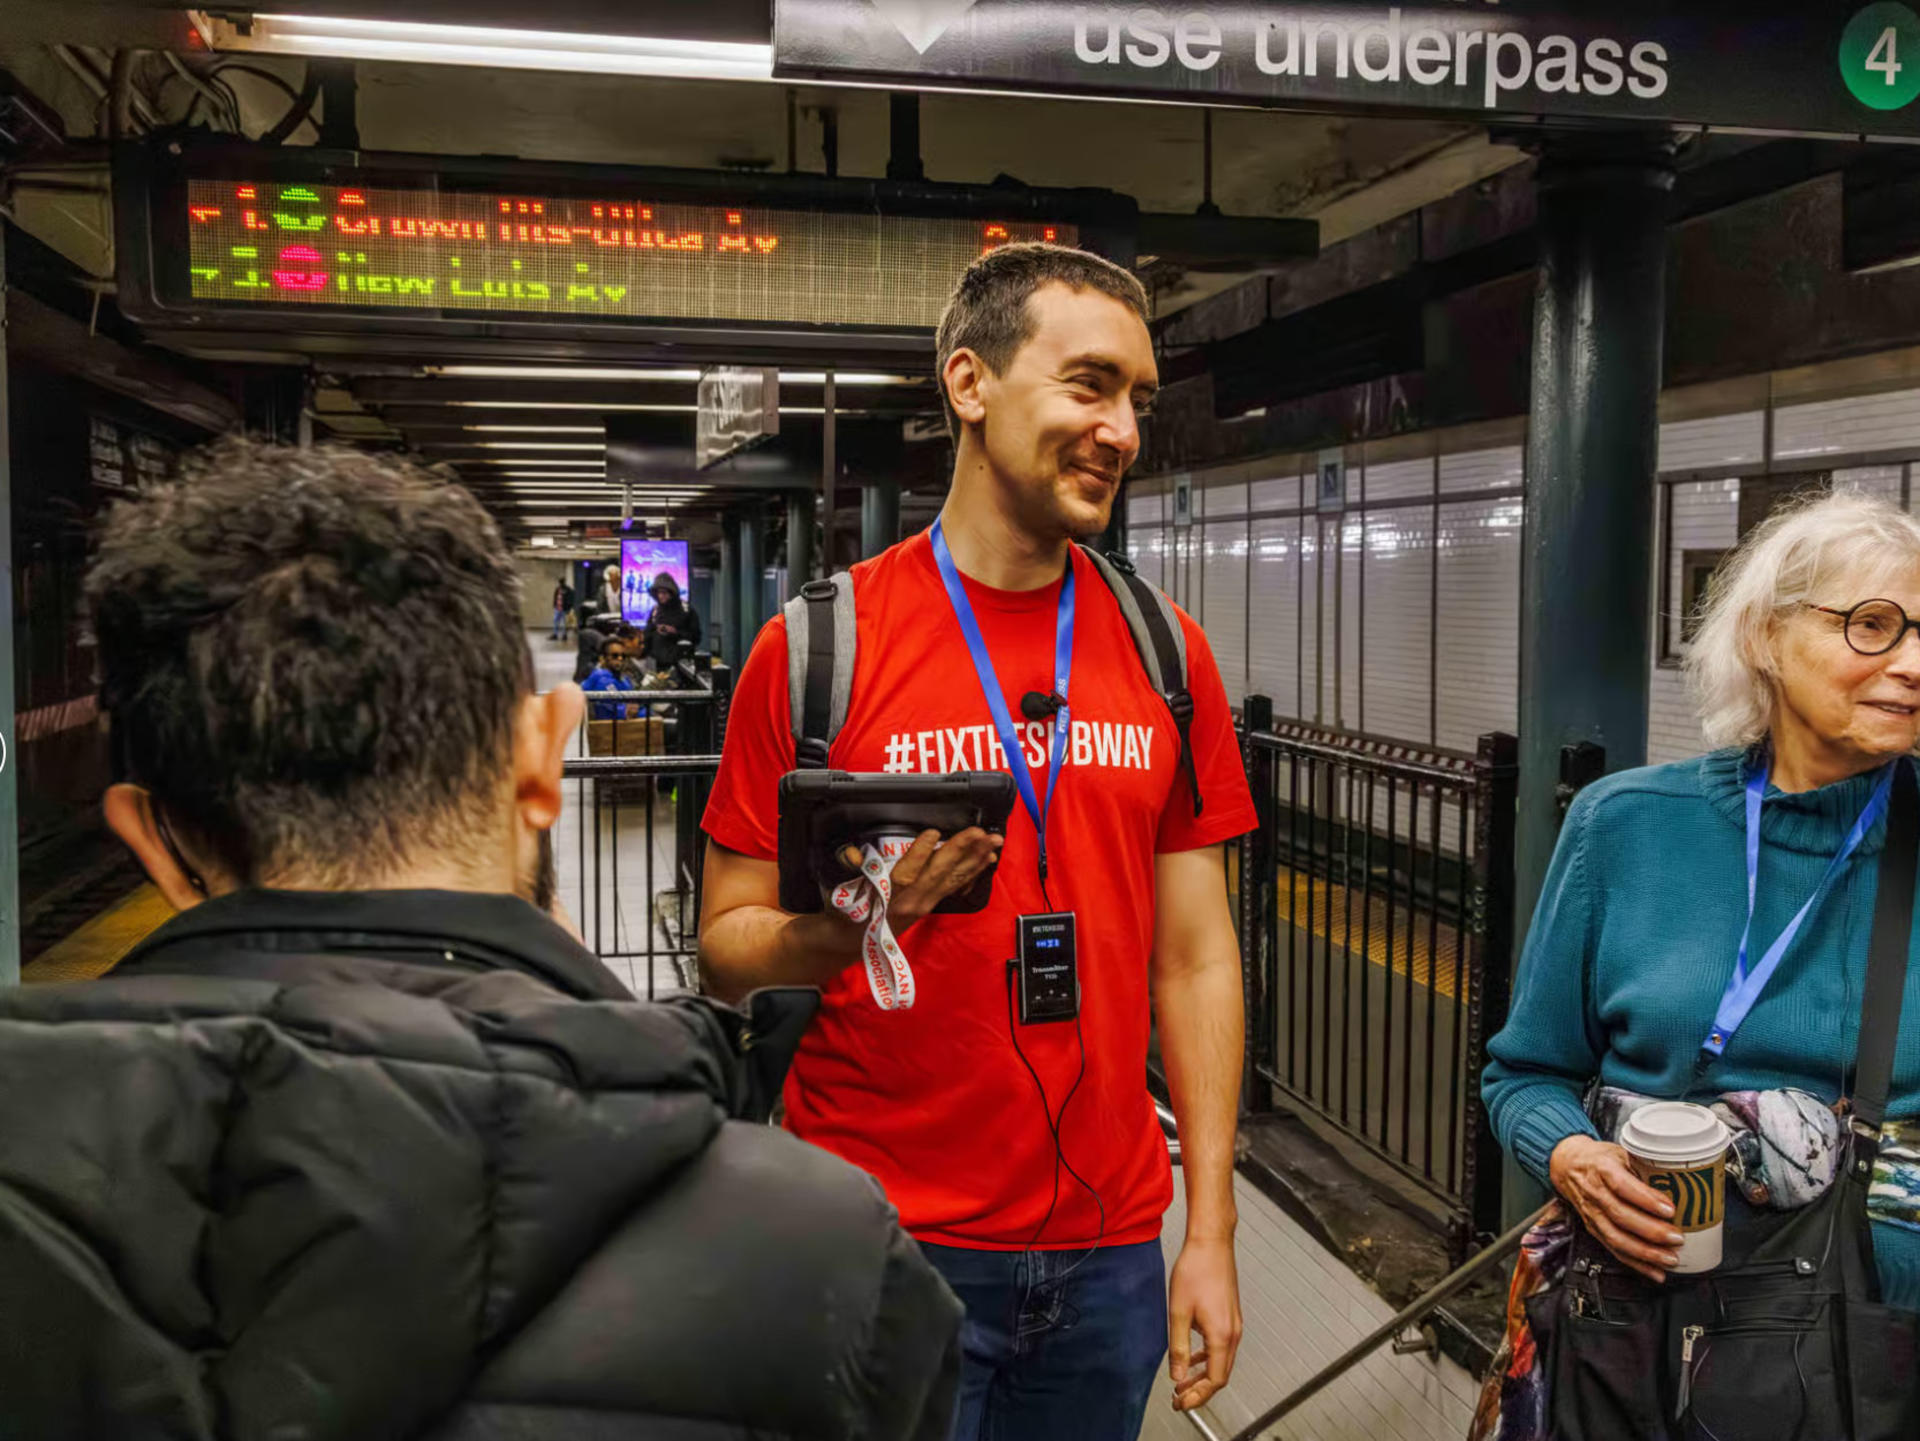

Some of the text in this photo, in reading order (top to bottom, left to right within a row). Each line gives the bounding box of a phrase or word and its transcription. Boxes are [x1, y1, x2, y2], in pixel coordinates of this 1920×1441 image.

[1073, 5, 1669, 108] use underpass
[1865, 26, 1902, 86] 4
